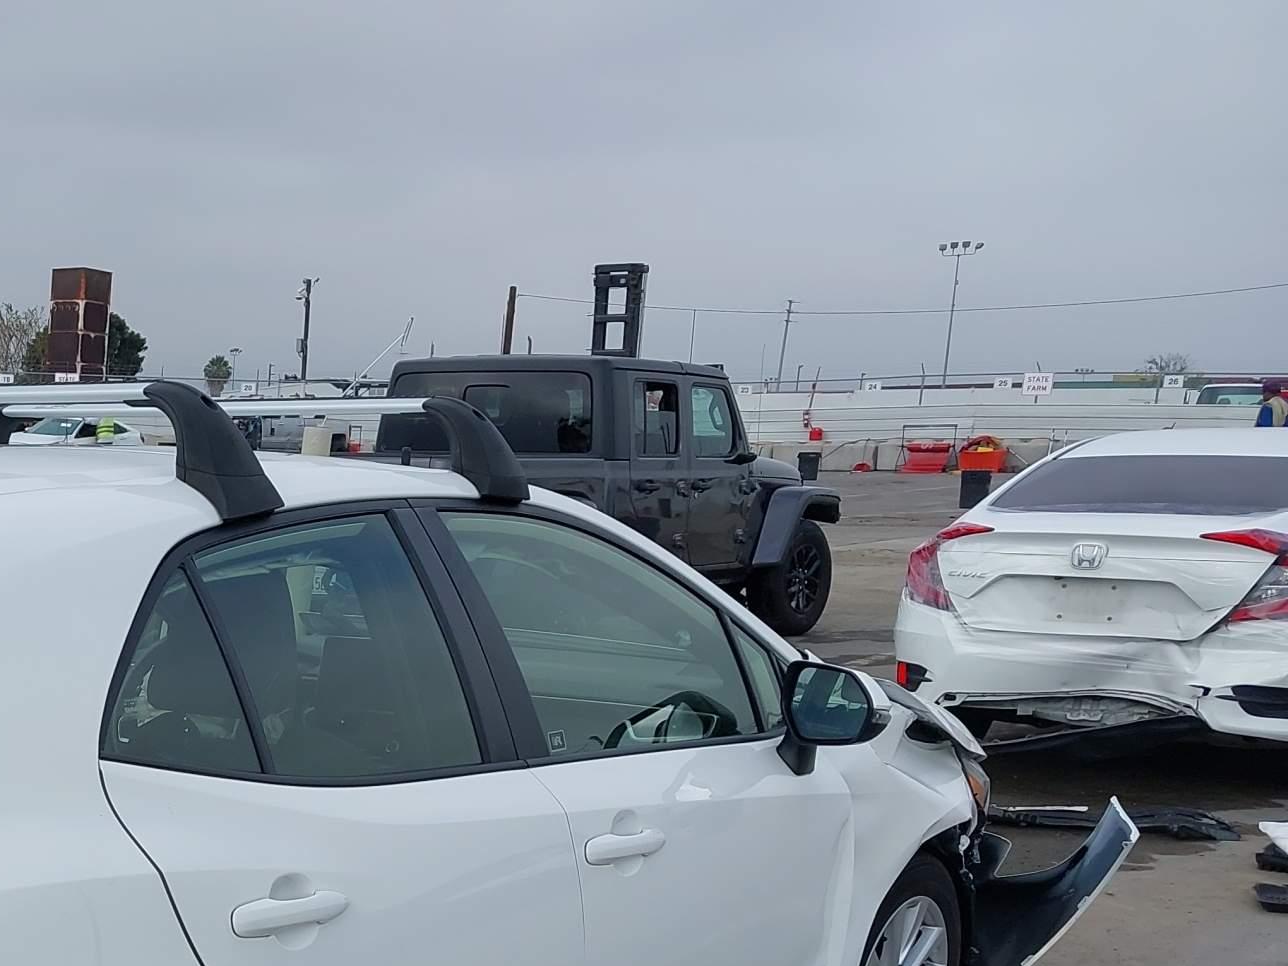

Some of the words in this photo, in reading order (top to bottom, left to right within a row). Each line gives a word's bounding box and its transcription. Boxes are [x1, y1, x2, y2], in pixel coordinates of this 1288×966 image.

[998, 379, 1008, 387] 25
[1167, 378, 1179, 386] 26
[948, 568, 991, 579] CIVIC
